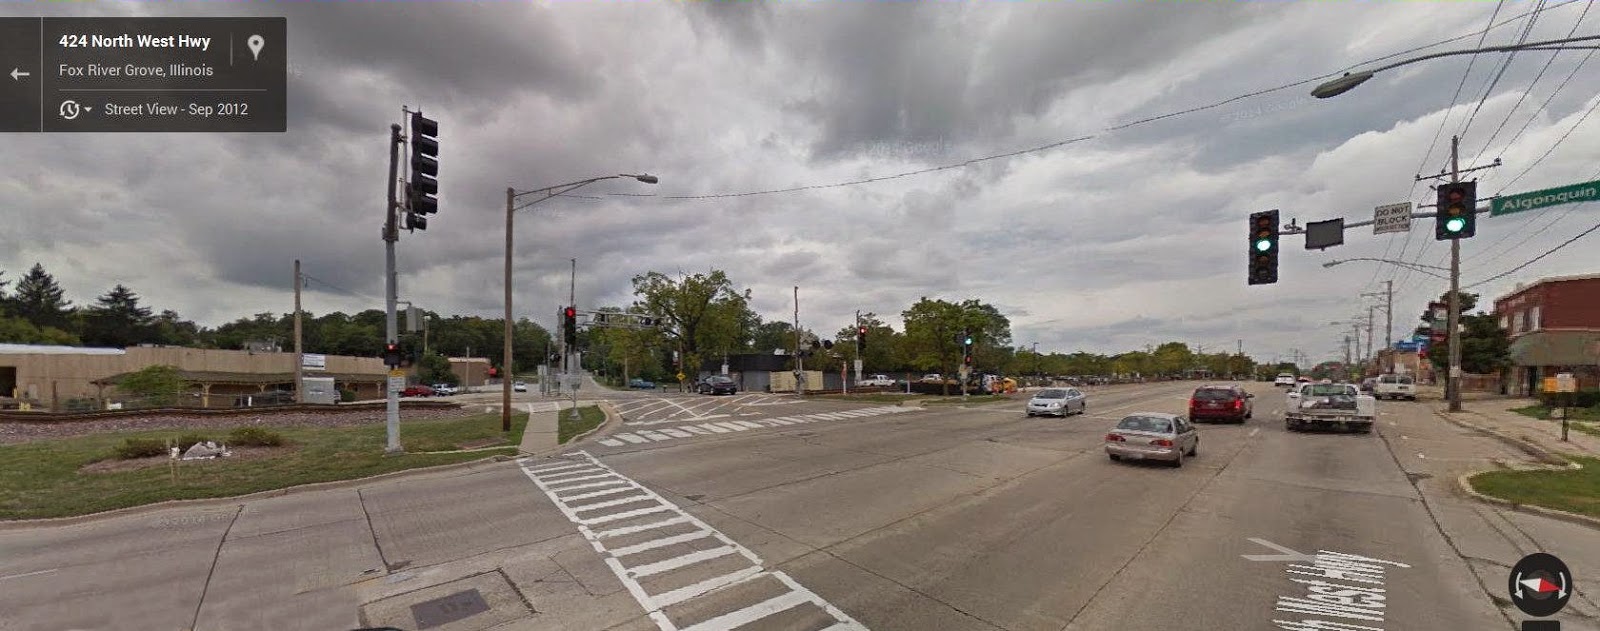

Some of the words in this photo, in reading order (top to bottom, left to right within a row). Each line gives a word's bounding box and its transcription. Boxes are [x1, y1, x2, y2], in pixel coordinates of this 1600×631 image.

[1500, 186, 1597, 211] Algonquin
[1376, 208, 1390, 217] DO
[1390, 205, 1409, 215] NOT
[1376, 215, 1408, 226] BLOCK
